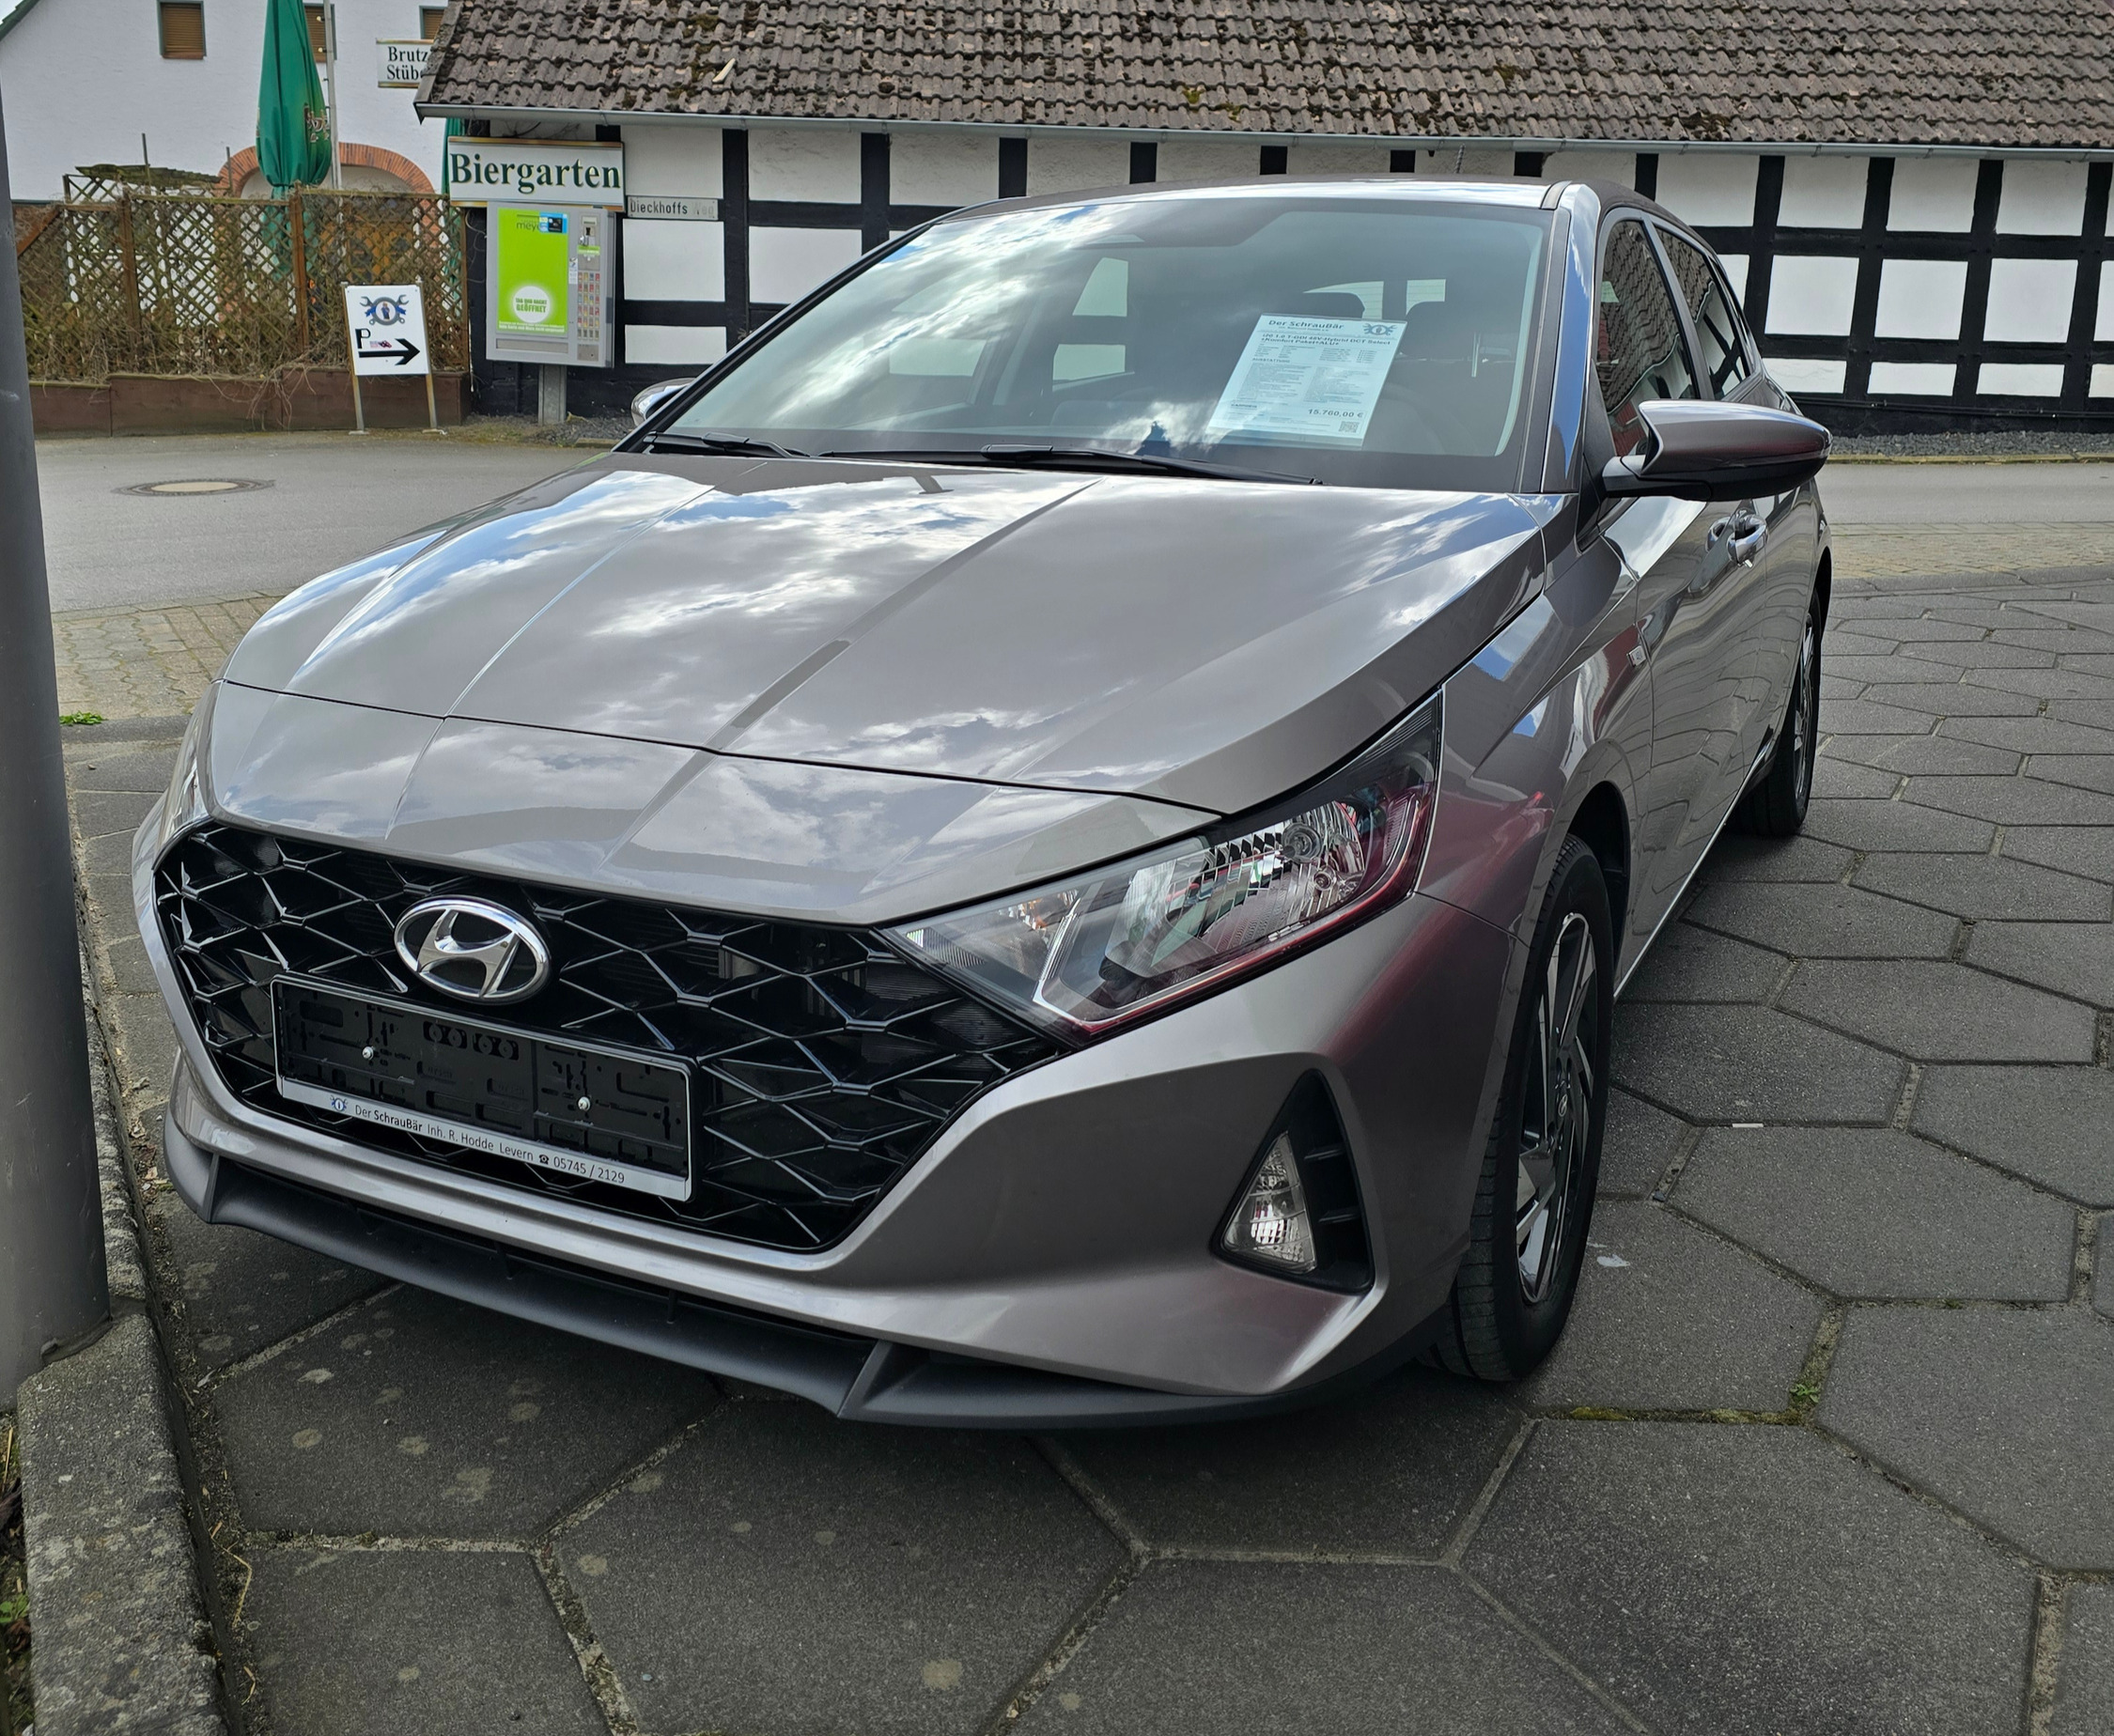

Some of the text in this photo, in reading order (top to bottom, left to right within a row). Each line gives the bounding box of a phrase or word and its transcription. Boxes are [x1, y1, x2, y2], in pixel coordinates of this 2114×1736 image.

[450, 152, 622, 194] Biergarten
[630, 200, 689, 215] Dieckhoffs
[355, 328, 371, 349] P
[1308, 408, 1355, 418] 15.760,00
[355, 1104, 626, 1184] Der SchrauBär Inh. R. Hodde Levern 05745 / 2129
